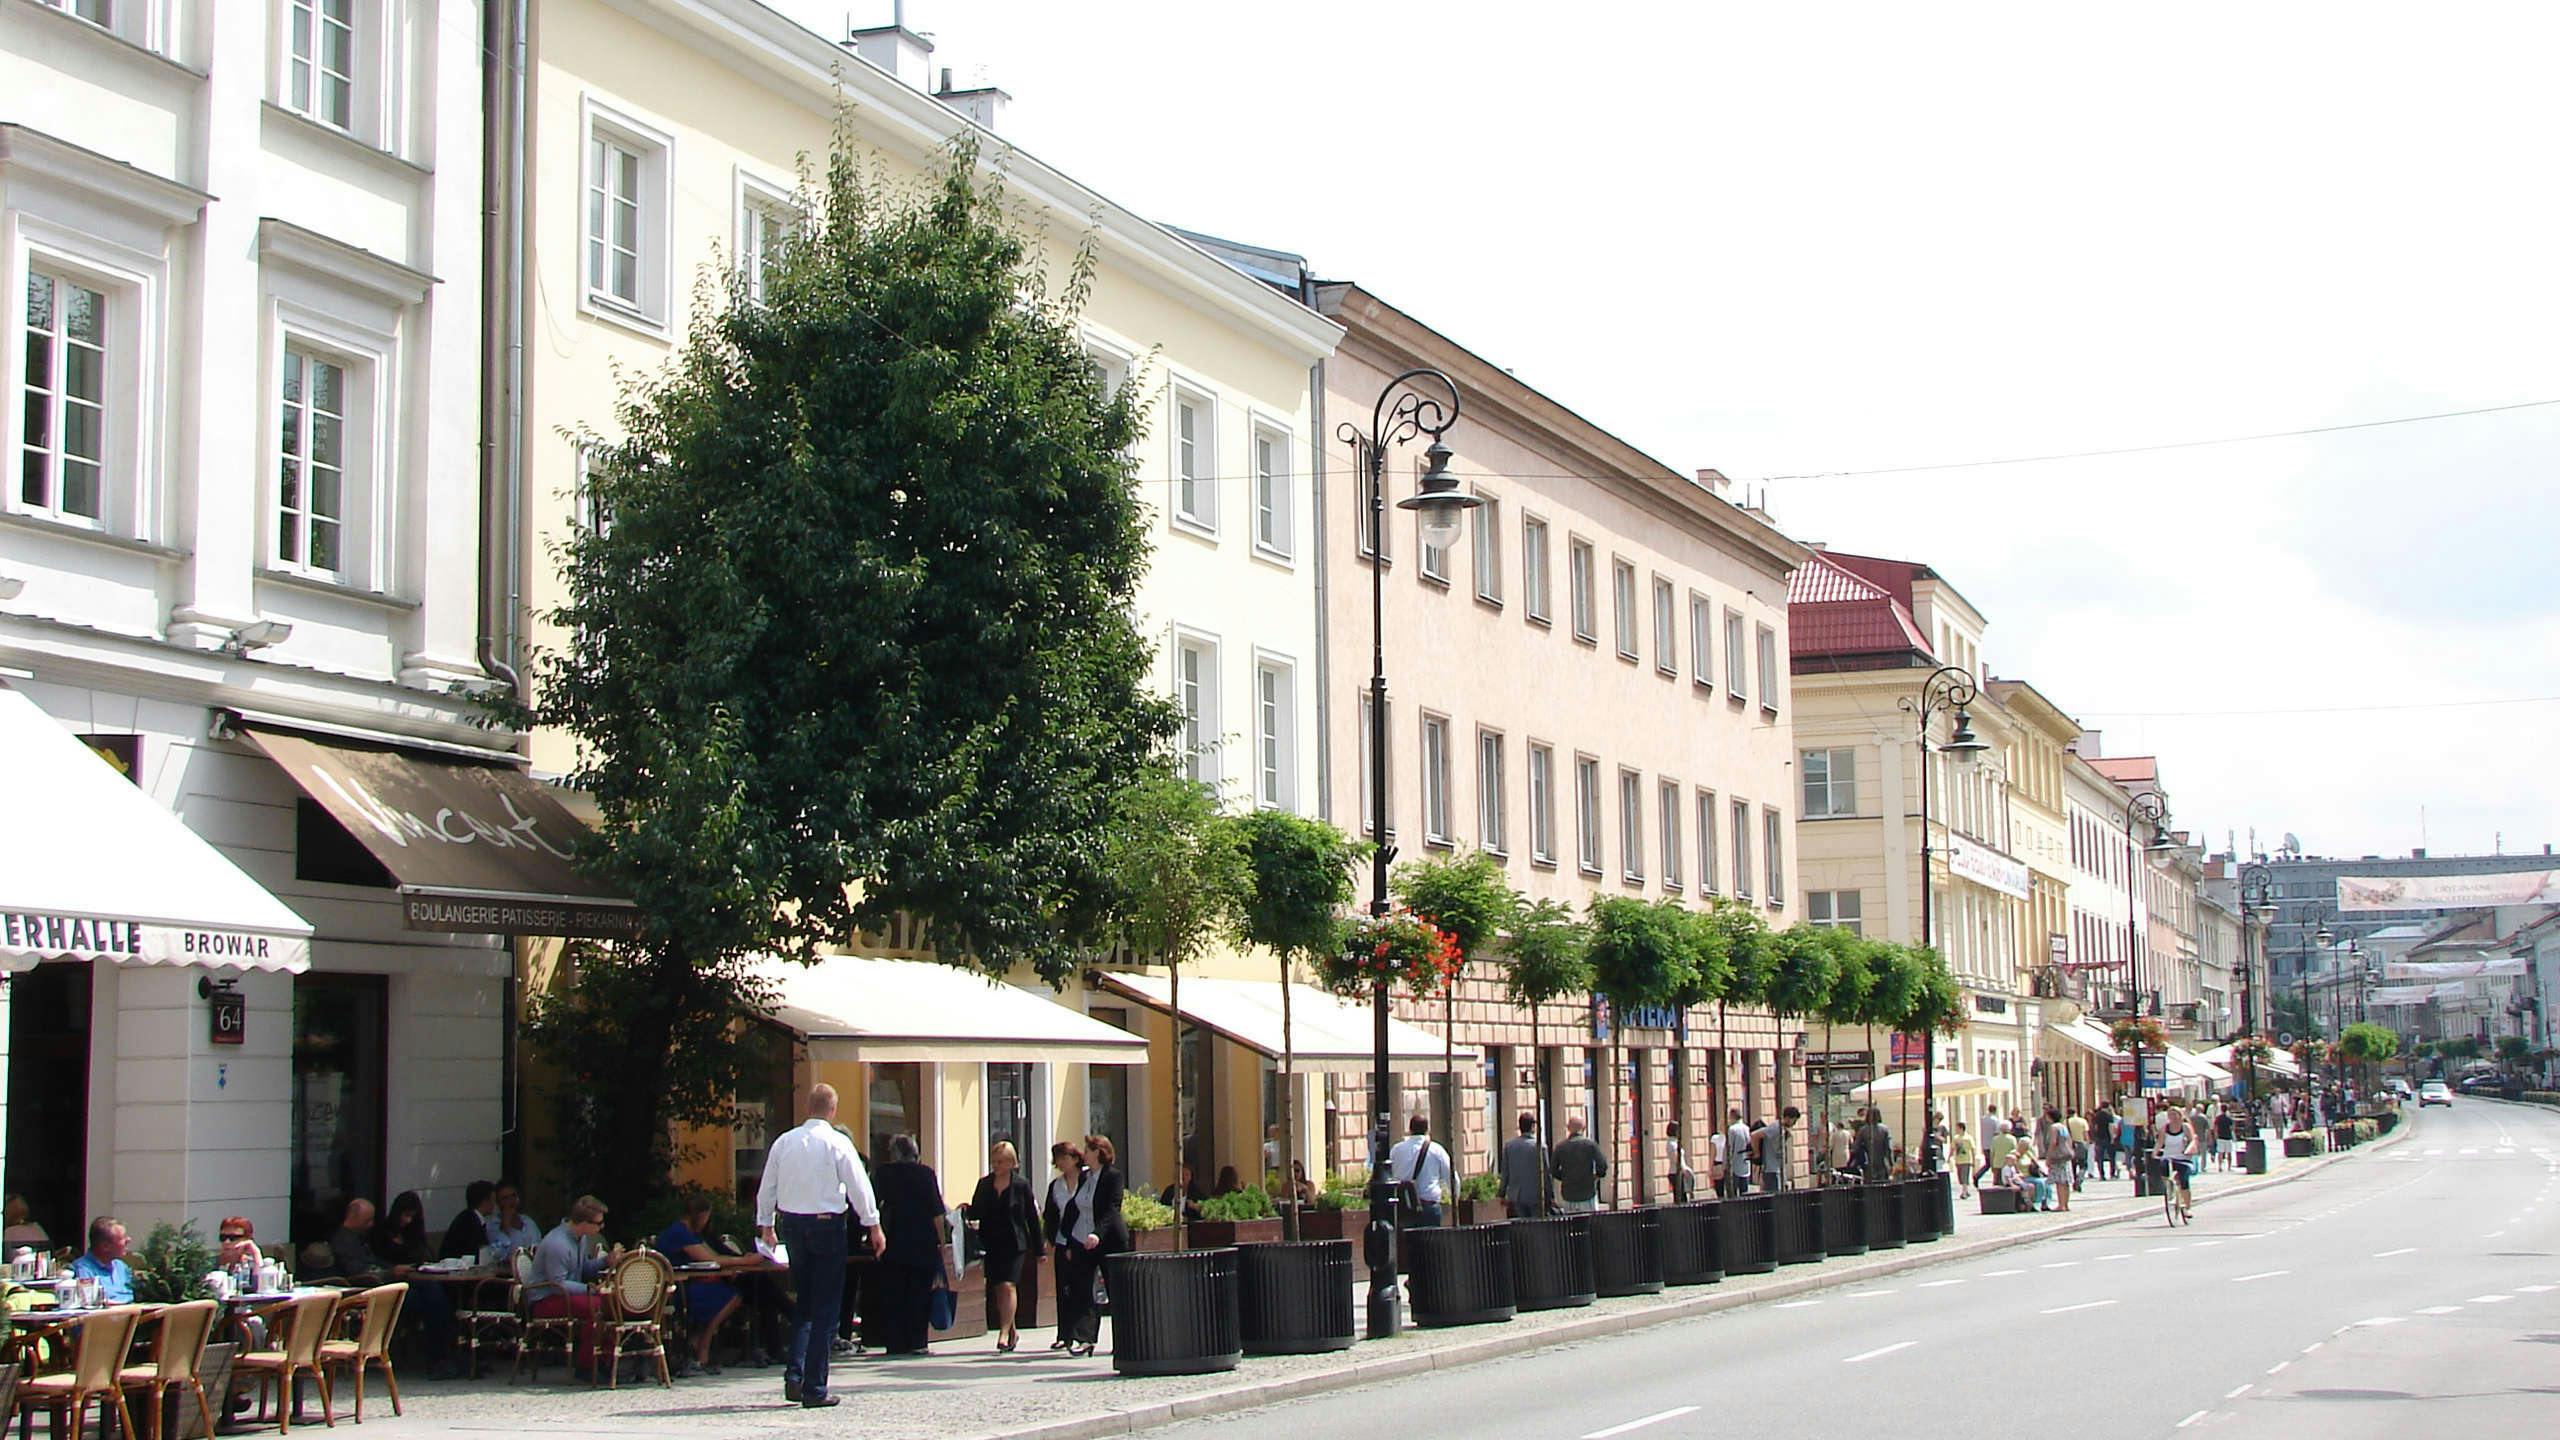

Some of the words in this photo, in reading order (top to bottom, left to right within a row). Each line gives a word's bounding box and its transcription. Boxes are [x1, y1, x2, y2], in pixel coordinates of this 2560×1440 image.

[311, 763, 576, 861] Vincent
[410, 902, 499, 925] BOULANGERIE
[502, 907, 567, 929] PATISSERIE
[0, 913, 142, 955] ERHALLE
[184, 931, 270, 959] BROWAR
[220, 1005, 242, 1031] 64
